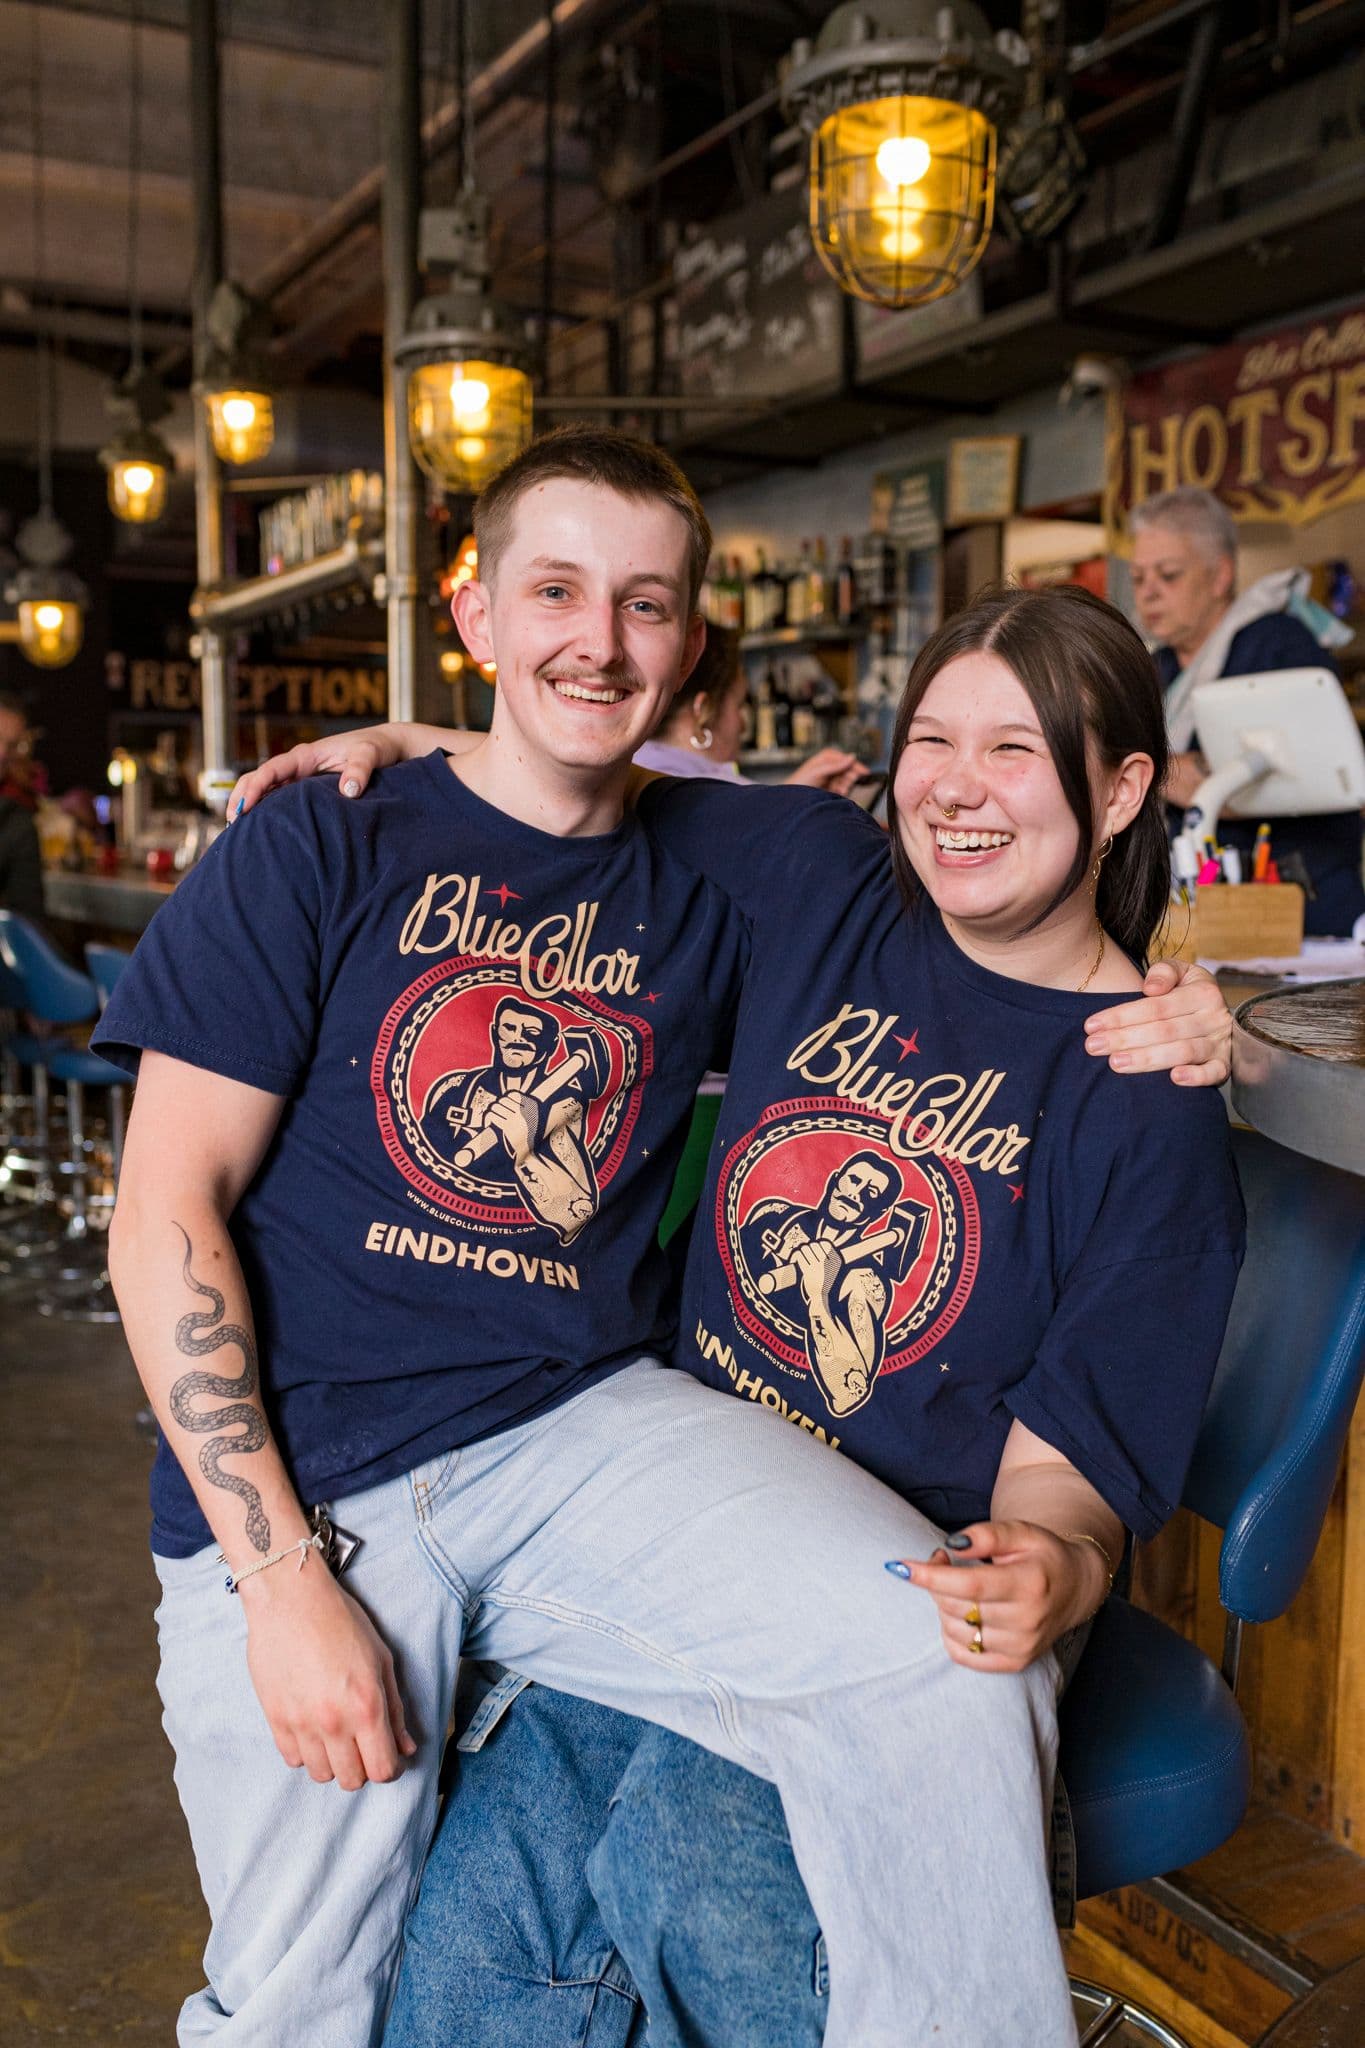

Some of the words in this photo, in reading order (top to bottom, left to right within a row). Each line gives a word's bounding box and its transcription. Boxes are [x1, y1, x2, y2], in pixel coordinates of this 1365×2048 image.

[131, 659, 386, 716] REPTION
[399, 873, 521, 960] Blue
[520, 901, 642, 999] Collar
[786, 1003, 912, 1117] Blue
[889, 1069, 1031, 1176] Collar
[364, 1221, 580, 1291] EINDHOVEN
[406, 1190, 537, 1235] WWW.BLUECOLLARHOTEL.COM
[695, 1318, 841, 1450] INDHOV
